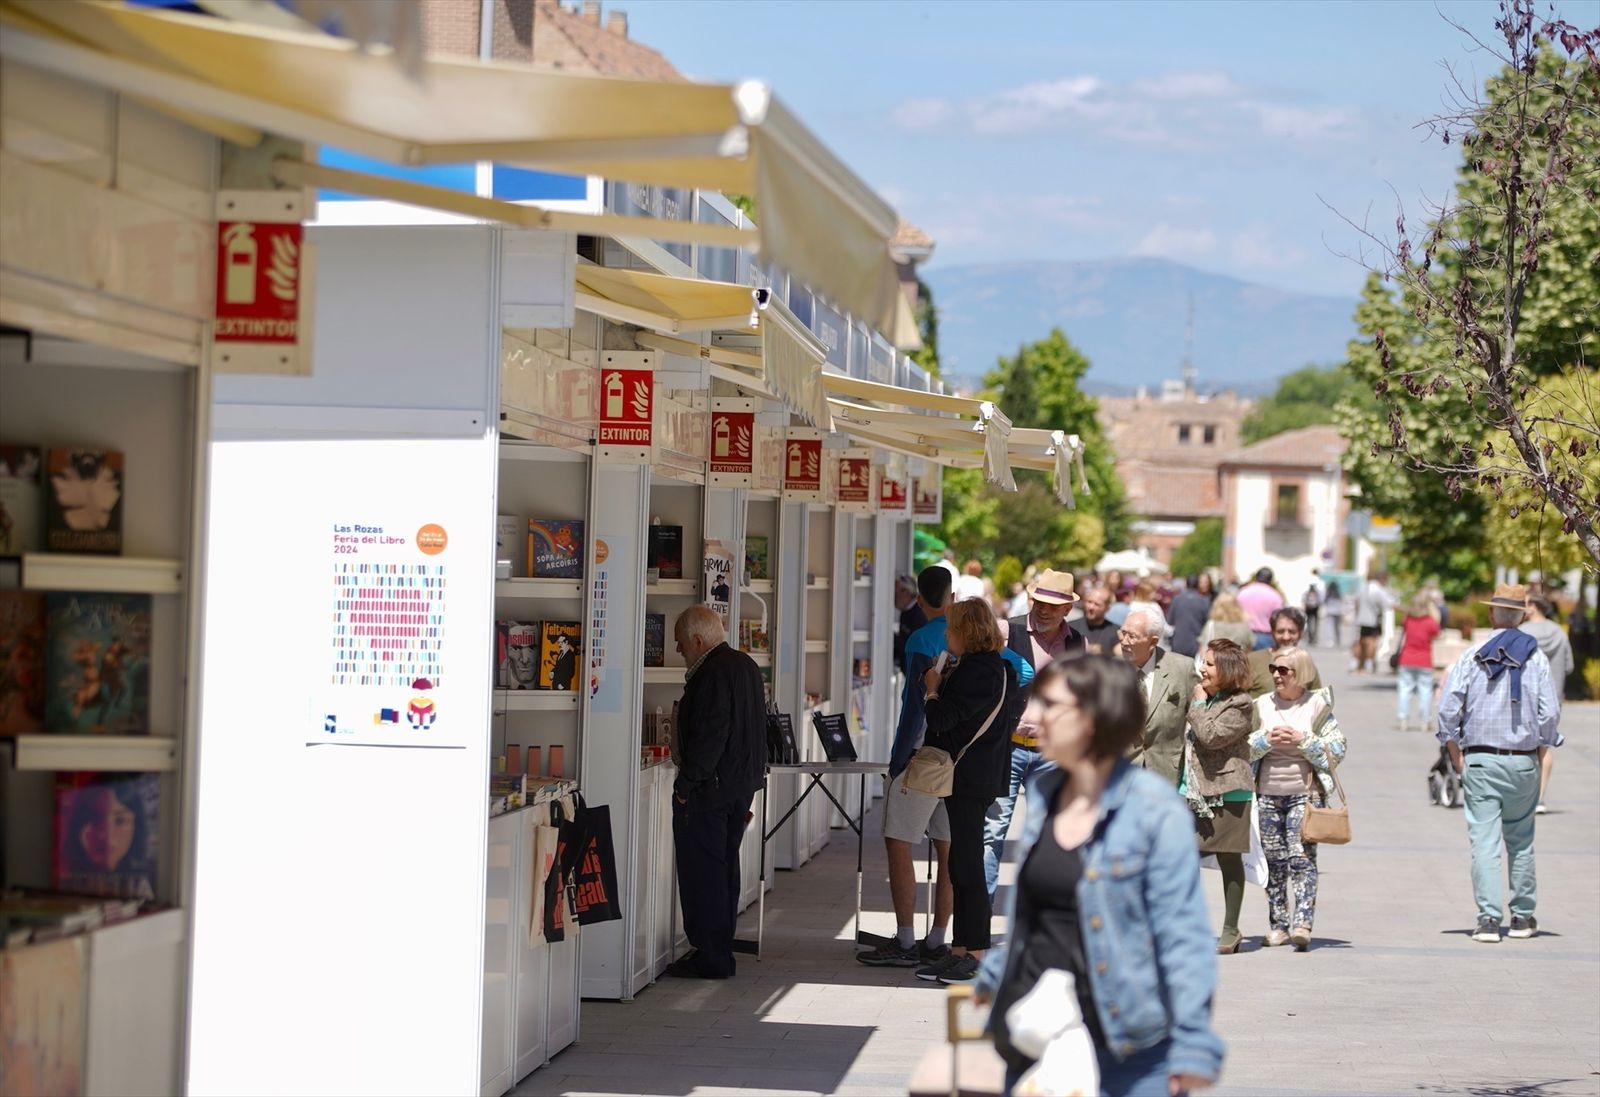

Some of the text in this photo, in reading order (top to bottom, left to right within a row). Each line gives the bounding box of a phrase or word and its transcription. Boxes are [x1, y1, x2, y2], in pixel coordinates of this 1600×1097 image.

[601, 427, 649, 441] EXTINTOR
[712, 464, 750, 473] EXTINTOR
[334, 524, 383, 533] Las Rozas
[334, 535, 405, 545] Feria del Libro
[334, 545, 358, 553] 2024
[536, 554, 555, 563] SOPA
[544, 622, 581, 636] Feltrinell
[509, 629, 536, 646] asolini
[576, 873, 609, 907] ead
